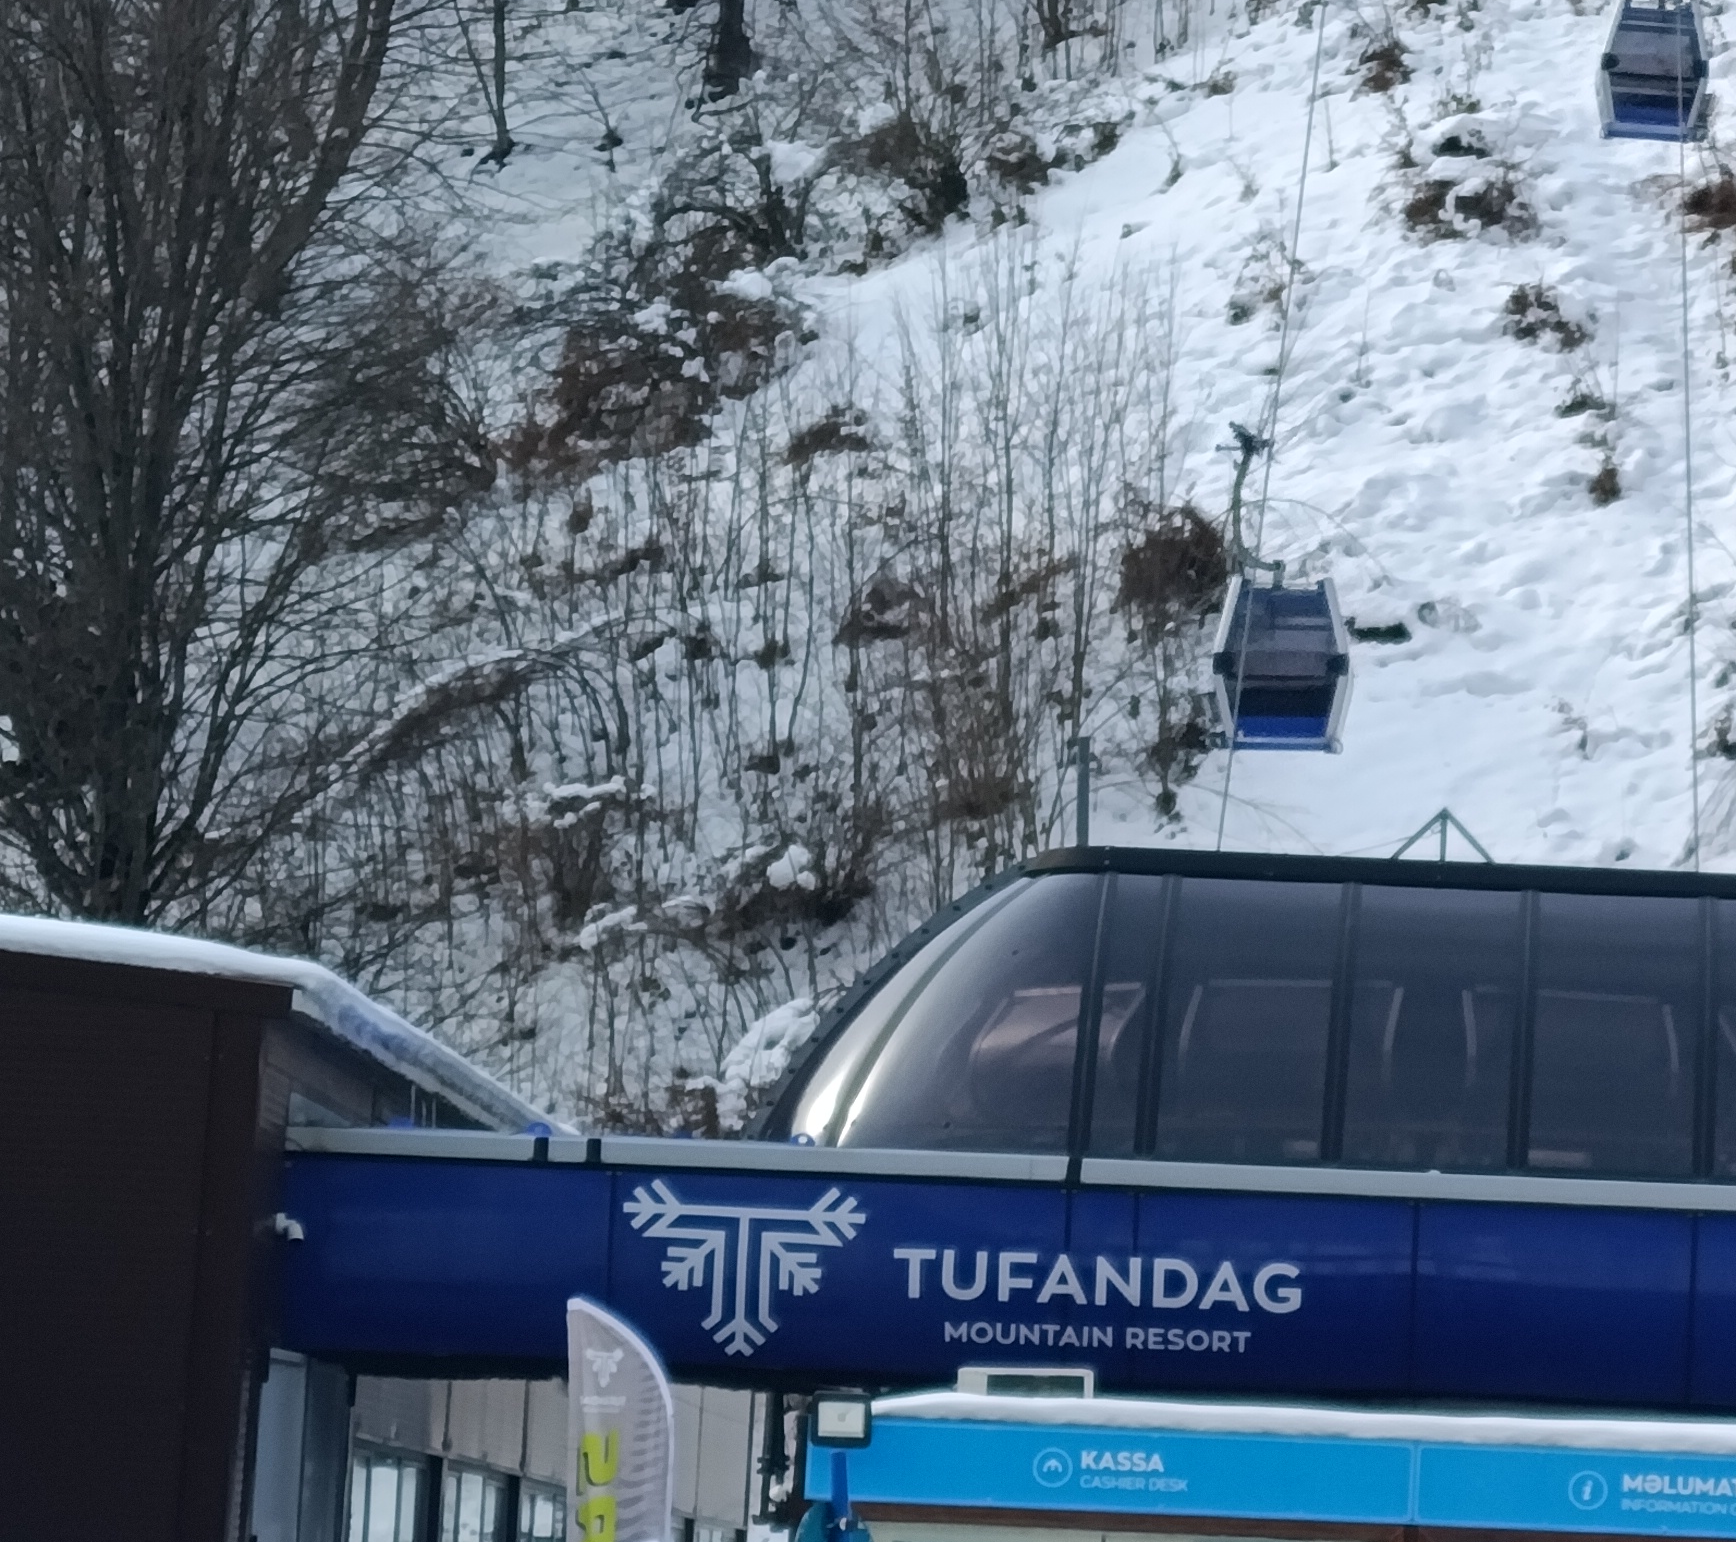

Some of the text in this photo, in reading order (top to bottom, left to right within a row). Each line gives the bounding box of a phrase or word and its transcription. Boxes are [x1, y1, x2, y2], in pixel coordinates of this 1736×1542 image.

[893, 1248, 1302, 1314] TUFANDAG
[944, 1320, 1253, 1354] MOUNTAIN RESORT
[1080, 1450, 1165, 1473] KASSA
[1079, 1475, 1189, 1492] CASHIER DESK
[1621, 1498, 1728, 1515] INFORMATION
